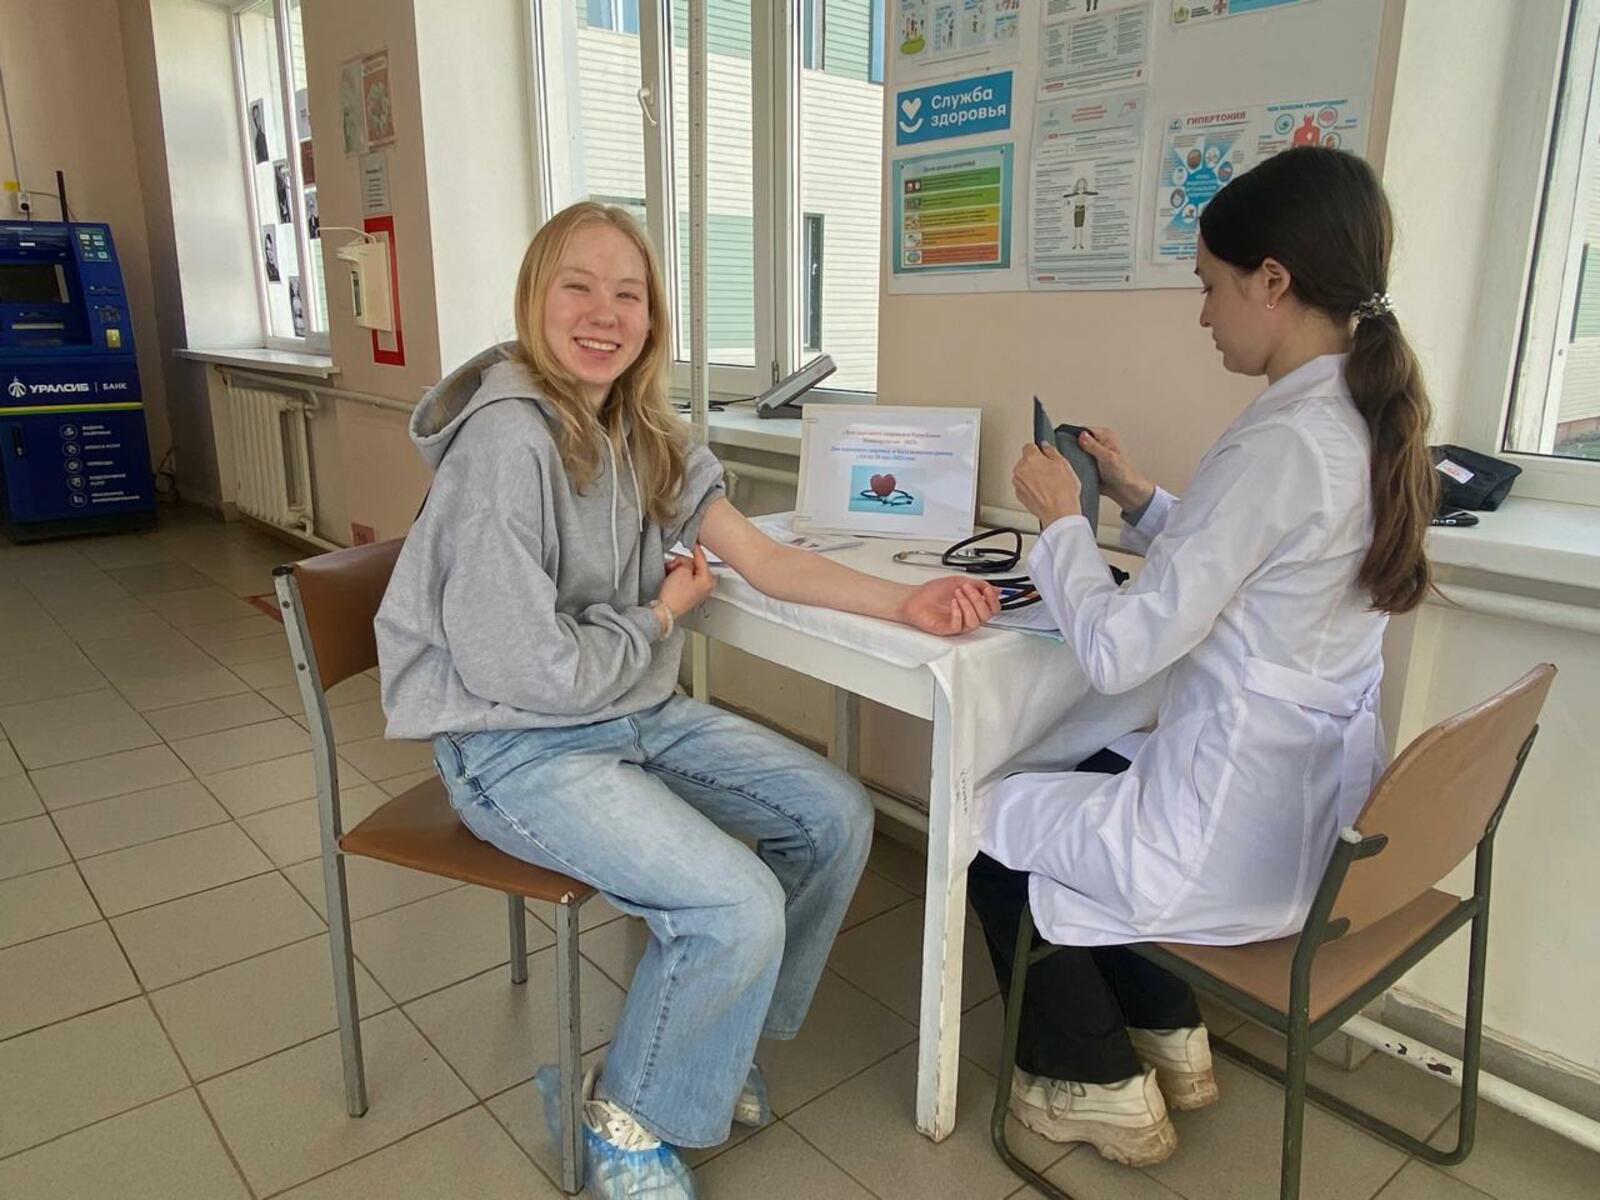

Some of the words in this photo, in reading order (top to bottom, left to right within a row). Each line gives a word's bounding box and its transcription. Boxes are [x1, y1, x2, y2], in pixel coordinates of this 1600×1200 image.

[931, 86, 993, 110] Служба
[931, 103, 1007, 127] здоровья
[1186, 111, 1246, 126] ГИПЕРТОНИЯ
[29, 383, 89, 393] УРАЛСИБ
[103, 382, 127, 391] БАНК
